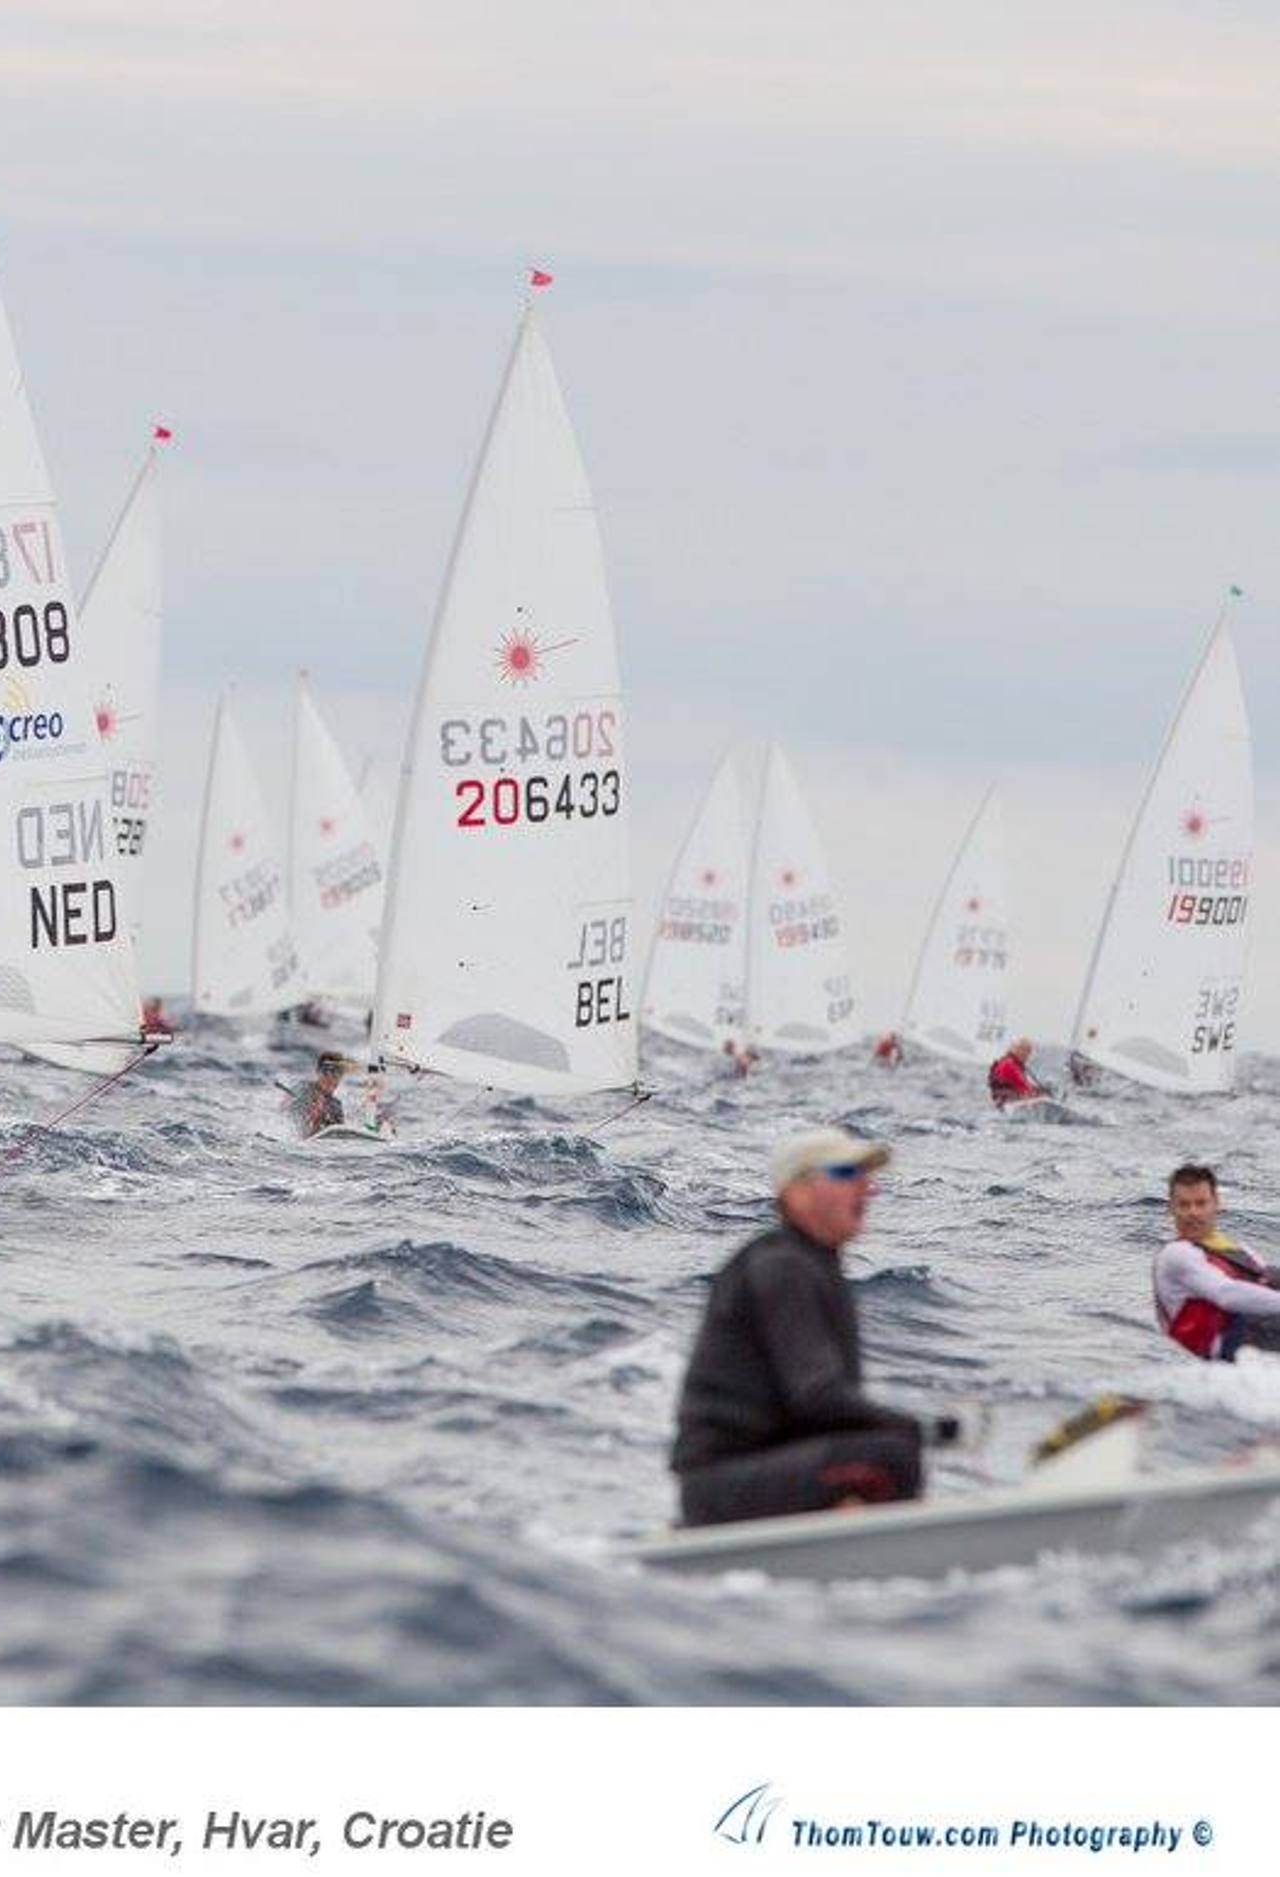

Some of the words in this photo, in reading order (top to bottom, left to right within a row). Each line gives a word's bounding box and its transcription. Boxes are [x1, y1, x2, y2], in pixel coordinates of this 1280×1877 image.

[456, 770, 621, 828] 206433
[30, 879, 117, 949] NED
[1167, 894, 1248, 926] 199001
[575, 976, 631, 1028] BEL
[1191, 1022, 1235, 1054] SWE
